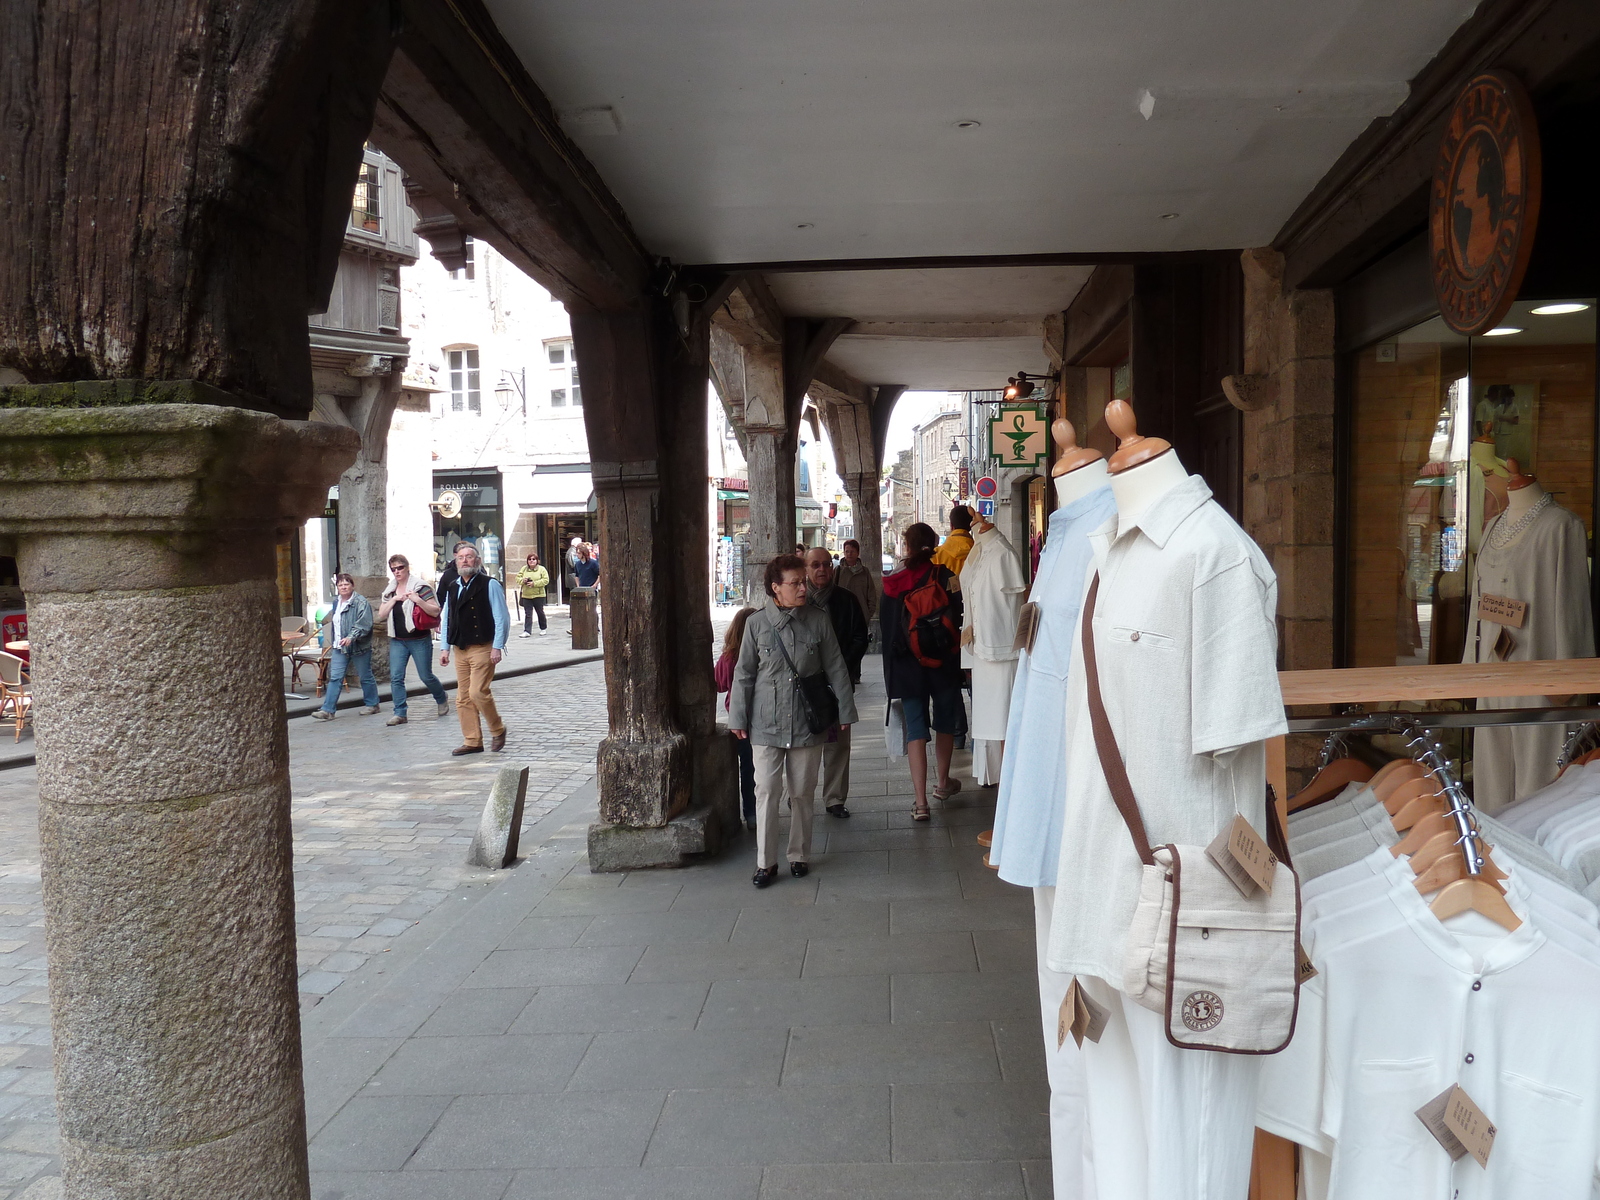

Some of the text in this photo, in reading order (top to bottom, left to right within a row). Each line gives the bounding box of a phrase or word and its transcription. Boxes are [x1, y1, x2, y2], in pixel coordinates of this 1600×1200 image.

[1433, 87, 1518, 209] THE EARTH
[1433, 193, 1520, 322] COLLECTION
[1483, 595, 1522, 611] Grande taille
[1185, 992, 1222, 1010] THE EARTH
[1184, 1011, 1220, 1029] COLLECTION
